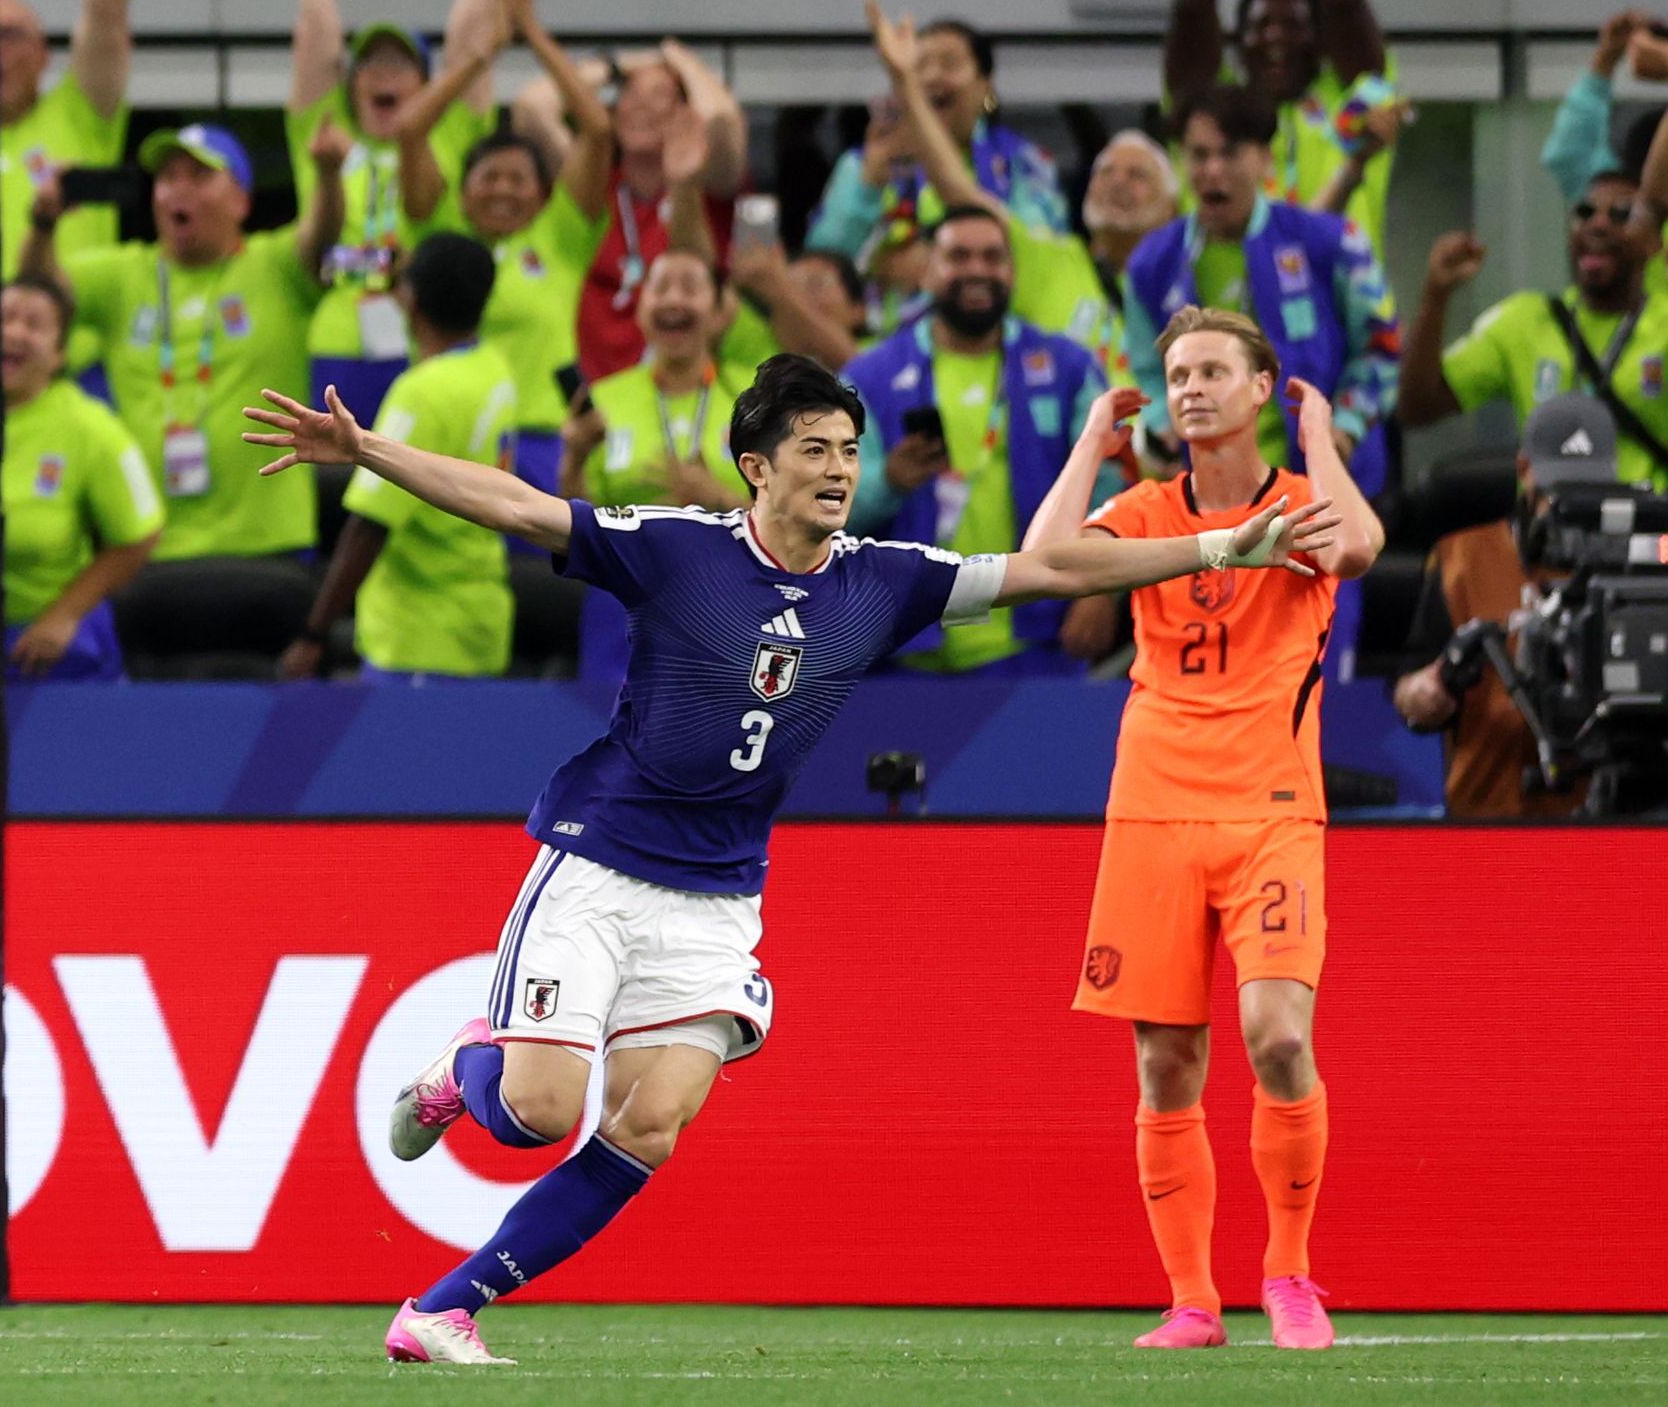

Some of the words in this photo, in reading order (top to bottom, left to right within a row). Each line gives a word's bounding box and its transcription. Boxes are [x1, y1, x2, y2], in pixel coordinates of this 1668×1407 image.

[767, 643, 794, 654] JAPAN
[1179, 620, 1230, 677] 21
[729, 709, 775, 773] 3
[1260, 878, 1308, 937] 21
